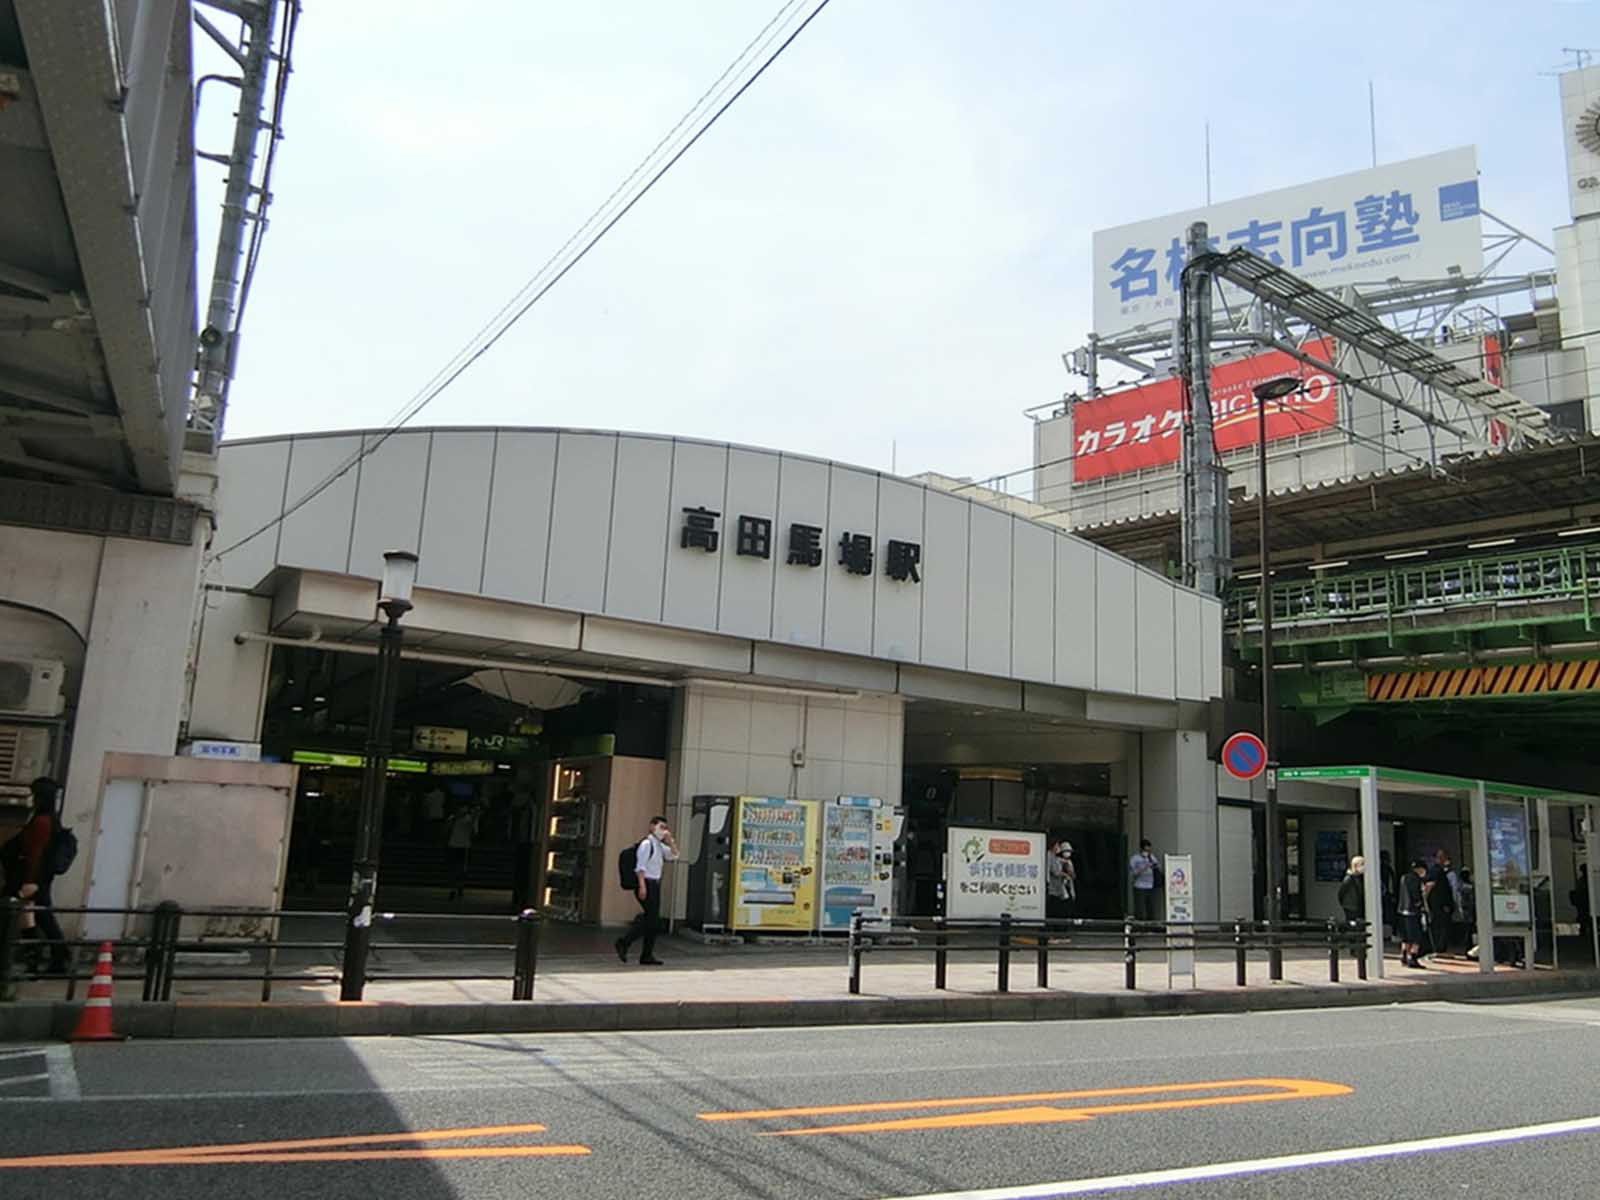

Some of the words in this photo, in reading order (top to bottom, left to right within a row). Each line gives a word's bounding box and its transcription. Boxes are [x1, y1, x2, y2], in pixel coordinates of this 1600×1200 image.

[680, 505, 921, 584] 高田馬場駅
[959, 881, 1038, 896] をご利用ください
